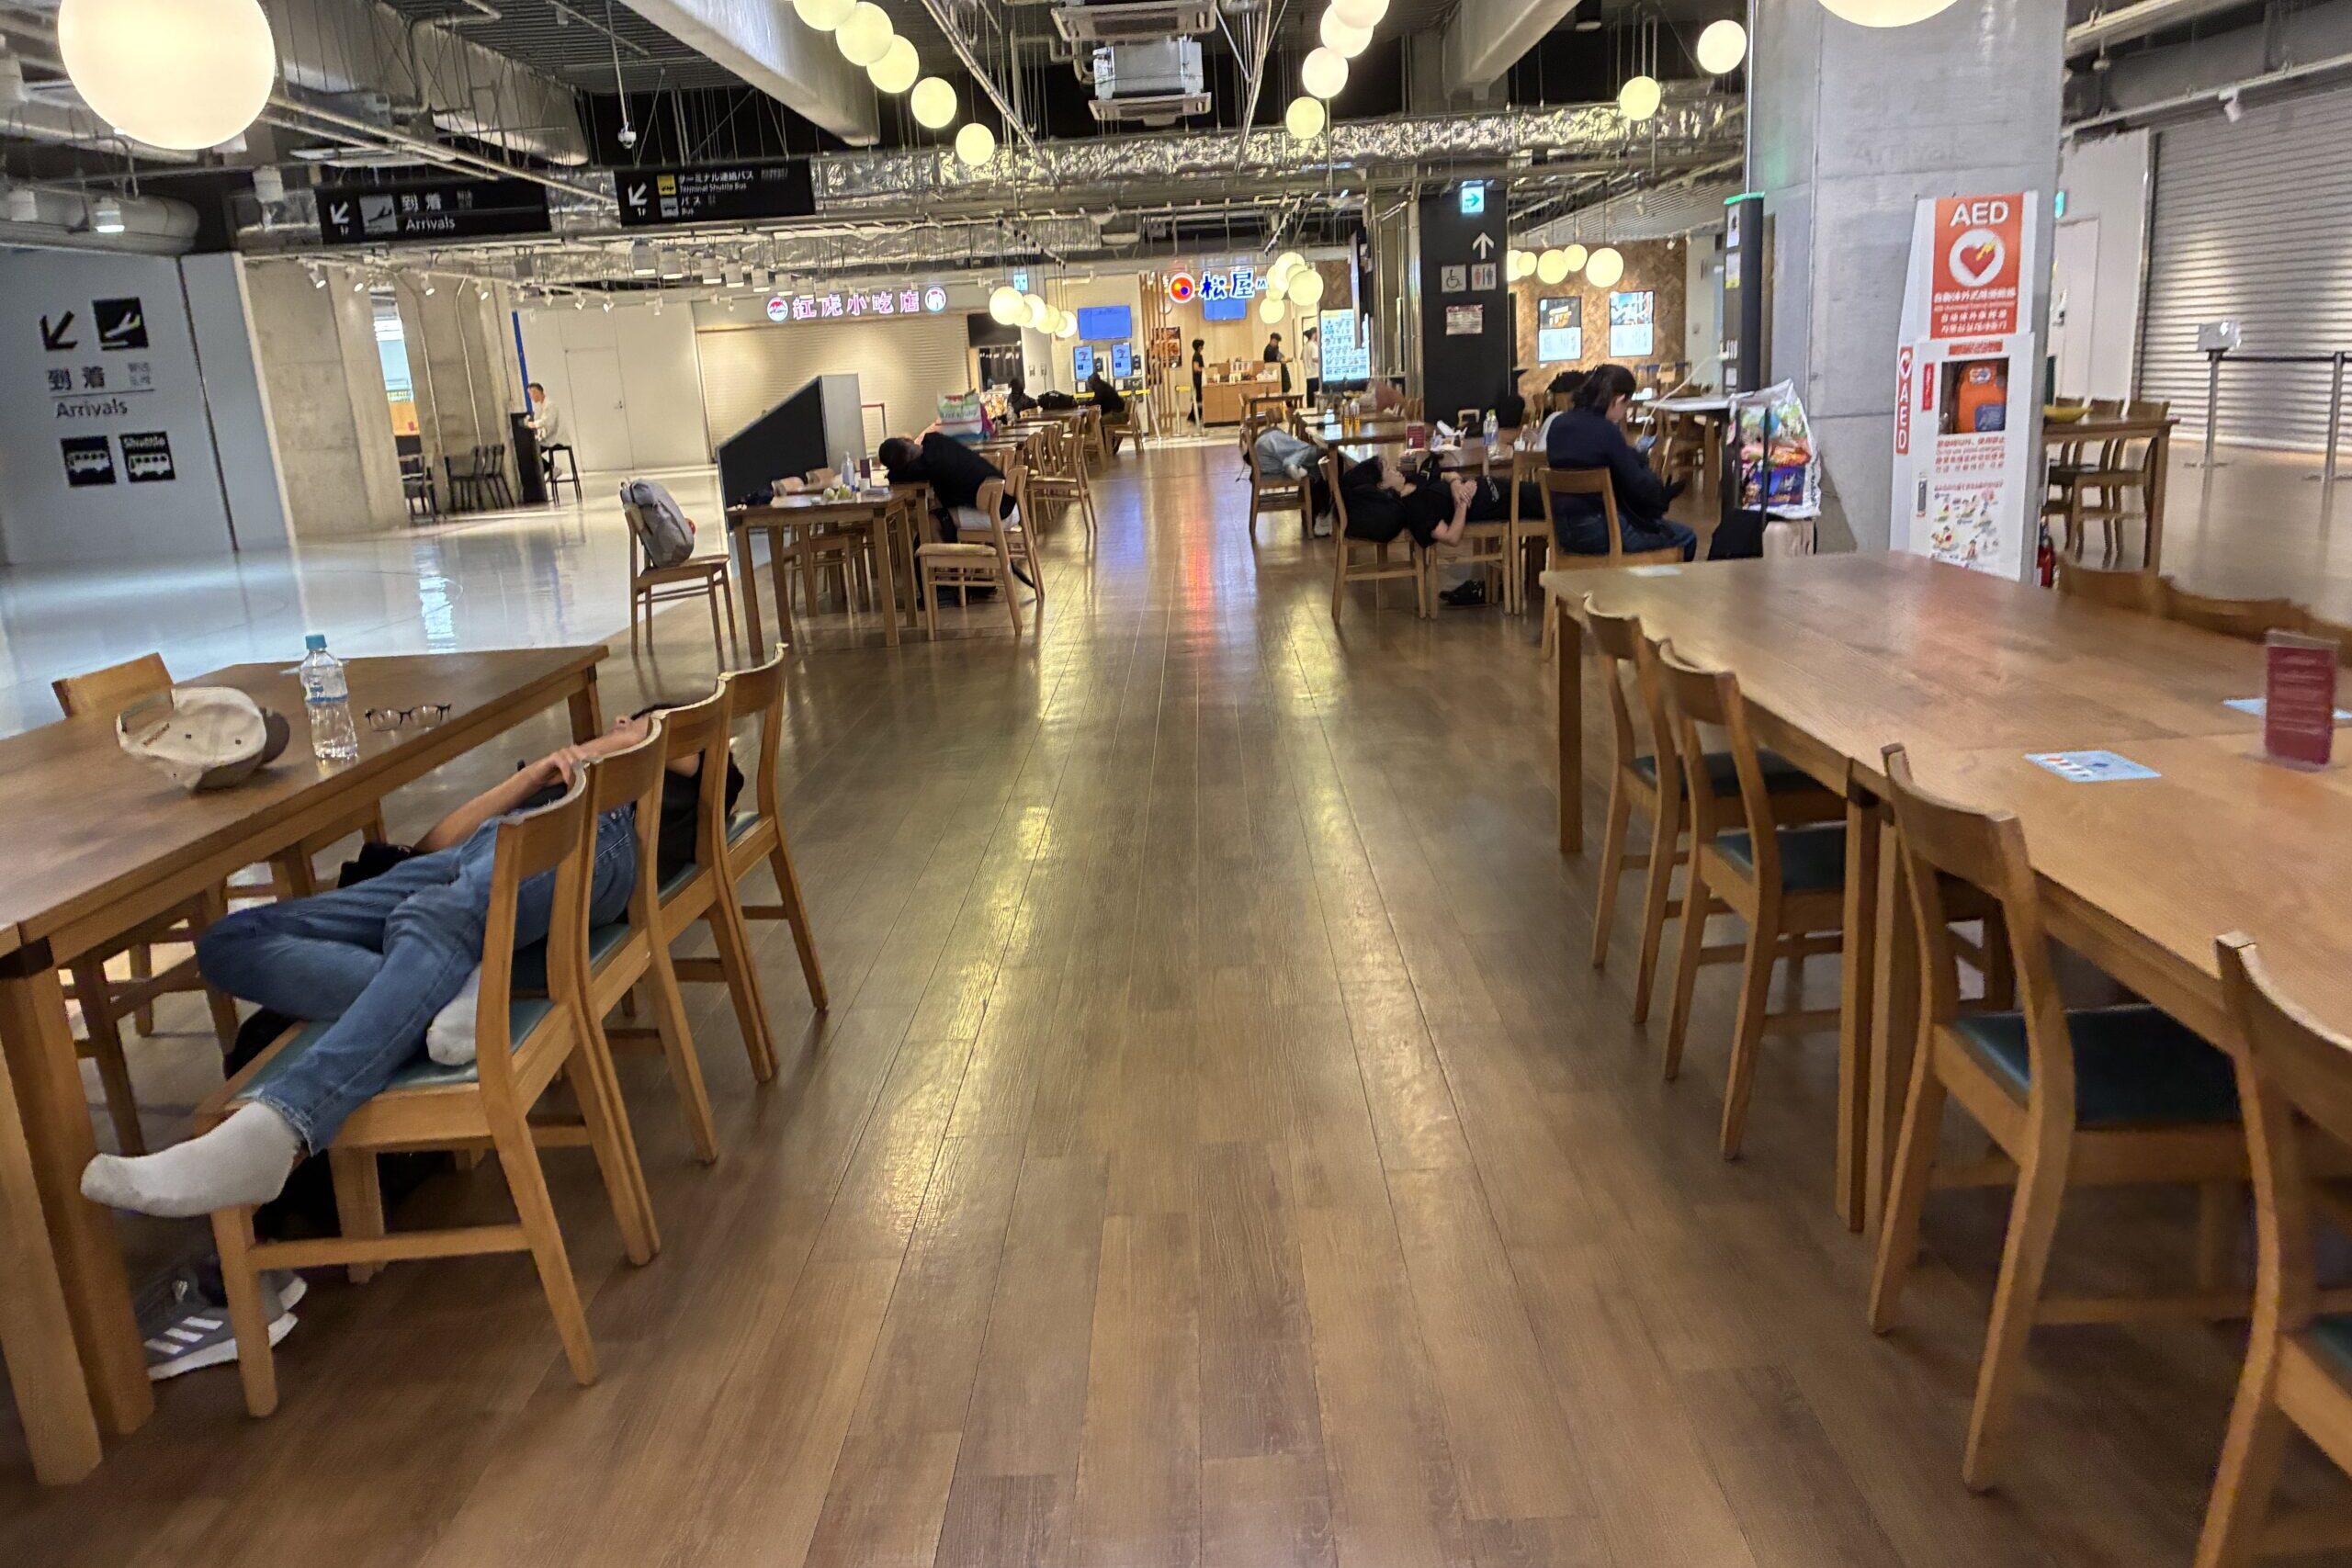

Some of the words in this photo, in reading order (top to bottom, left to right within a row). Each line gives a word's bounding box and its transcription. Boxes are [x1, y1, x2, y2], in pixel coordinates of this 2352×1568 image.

[405, 216, 456, 231] Arrivals
[1950, 200, 2008, 228] AED
[1199, 271, 1253, 299] 松屋
[47, 366, 105, 390] 到着
[56, 398, 128, 419] Arrivals
[1897, 382, 1909, 449] AED
